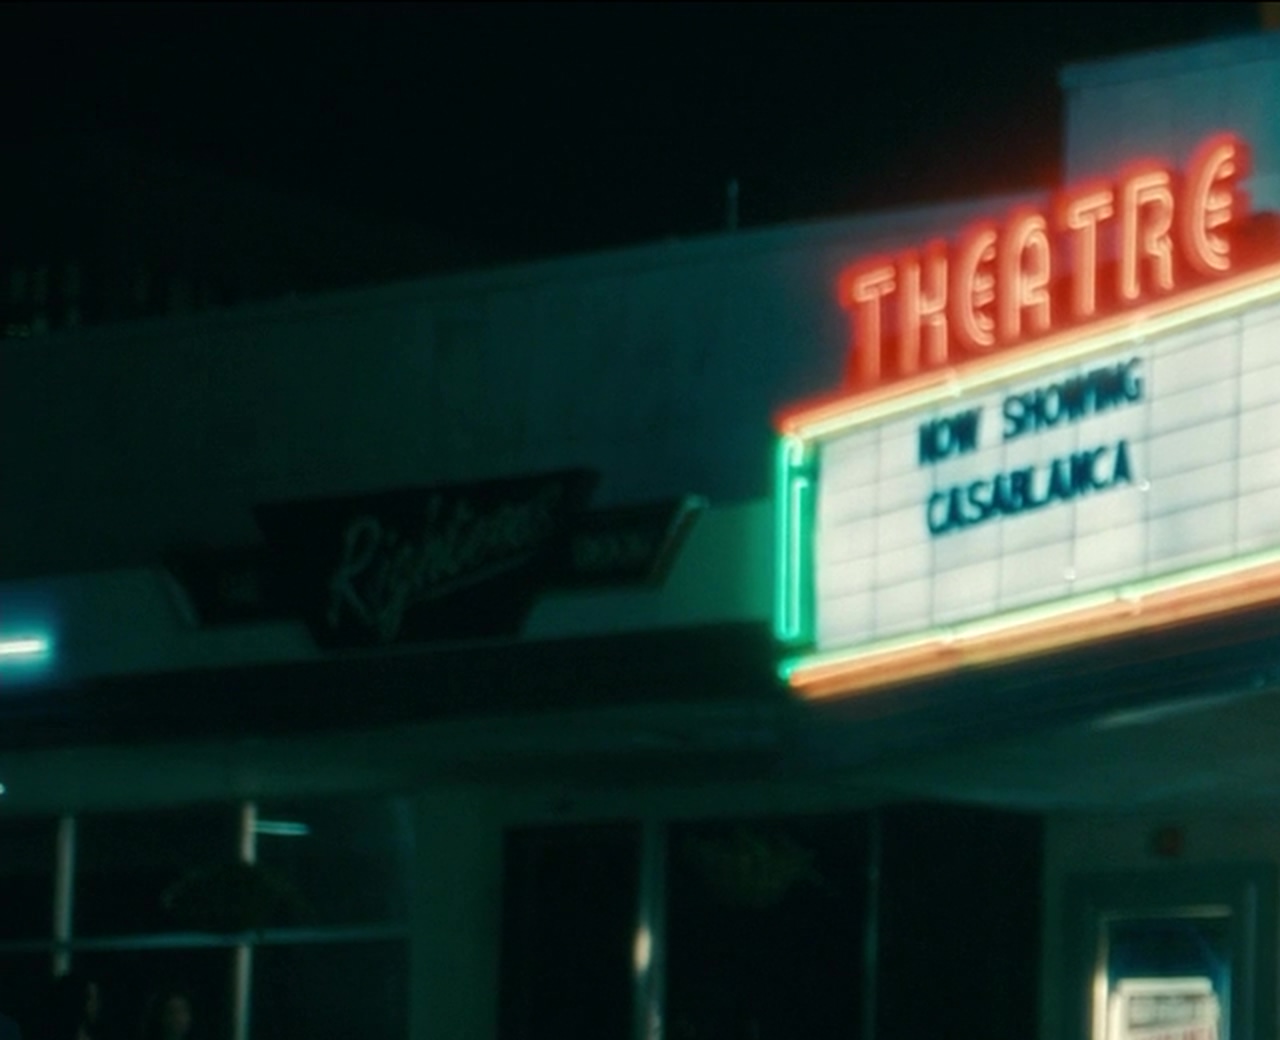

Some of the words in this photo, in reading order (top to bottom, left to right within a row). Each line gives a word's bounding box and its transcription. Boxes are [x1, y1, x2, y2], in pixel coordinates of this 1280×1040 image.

[845, 140, 1240, 380] THEATRE
[917, 407, 983, 466] NOW
[1001, 356, 1145, 440] SHOWING
[925, 440, 1133, 537] CASABLANCA
